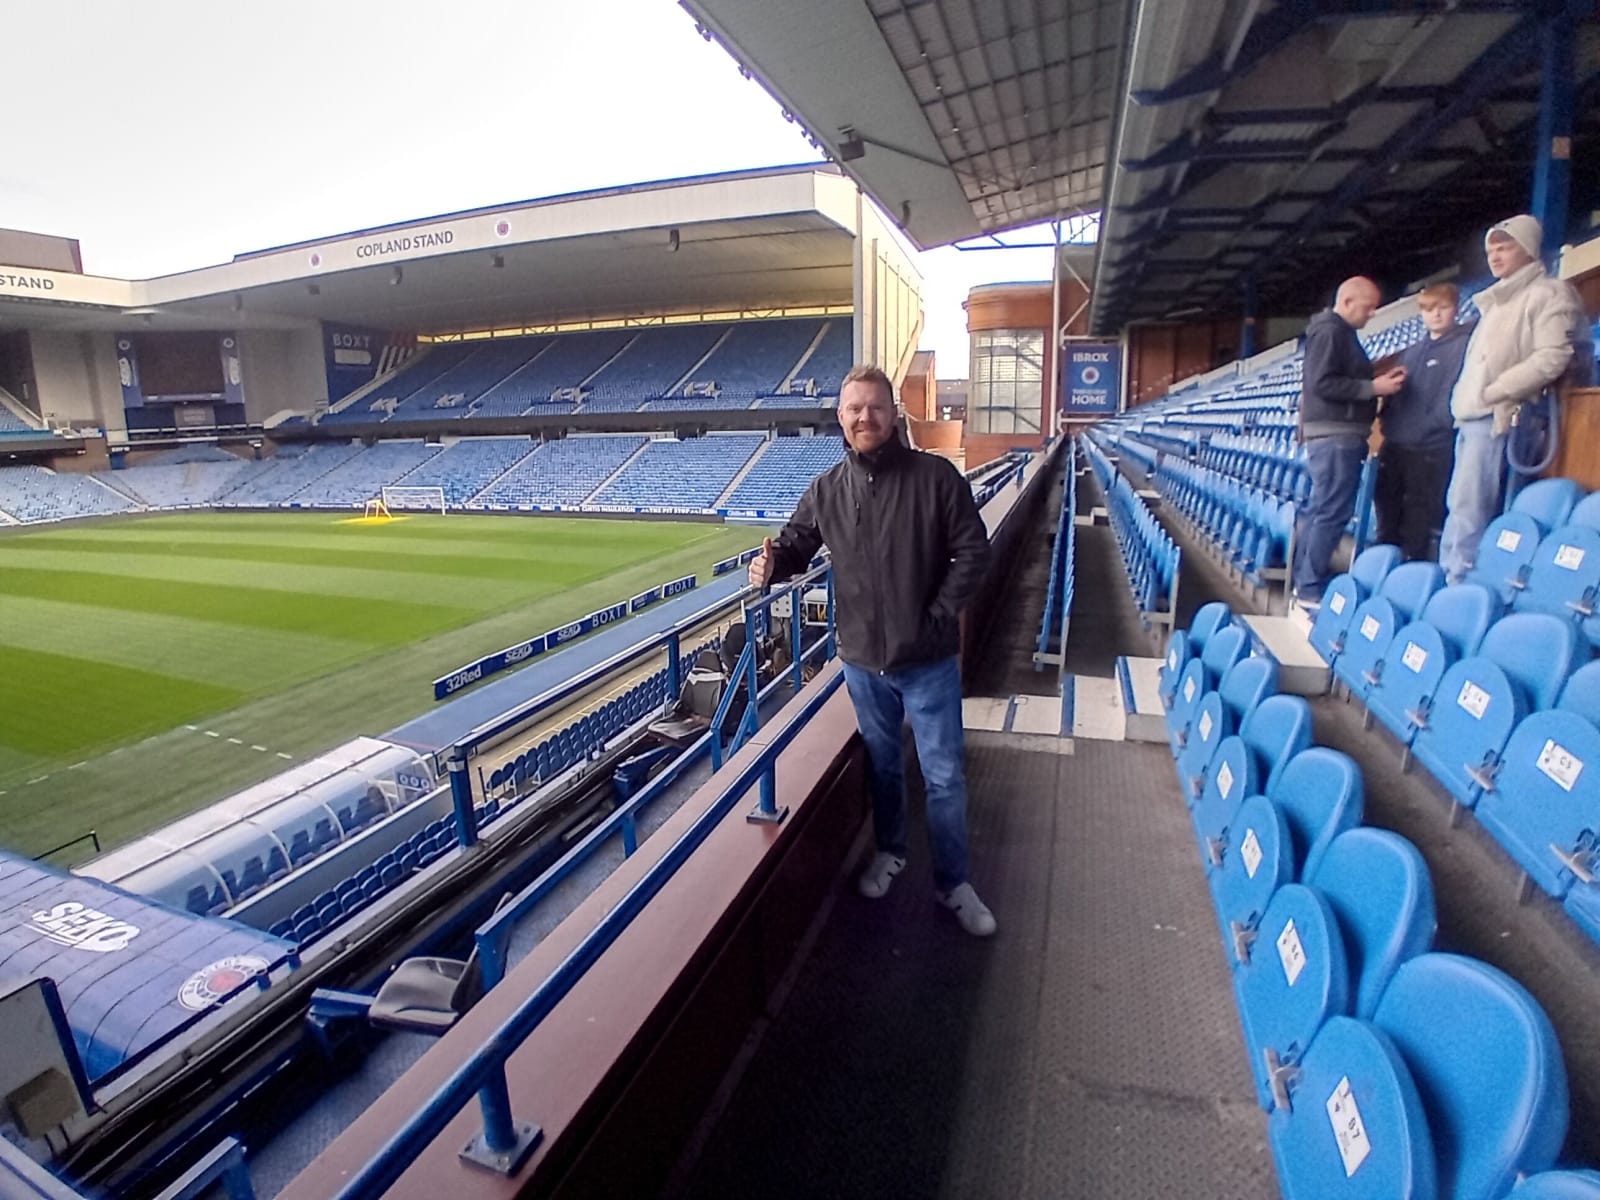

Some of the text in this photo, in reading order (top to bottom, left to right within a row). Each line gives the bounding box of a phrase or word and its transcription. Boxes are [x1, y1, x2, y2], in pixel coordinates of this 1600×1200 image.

[356, 230, 453, 258] COPLAND STAND
[333, 333, 370, 349] BOXT
[1072, 352, 1109, 363] IBROX
[1071, 395, 1107, 405] HOME
[668, 578, 694, 596] BOXT
[592, 606, 621, 628] BOXT
[504, 643, 533, 664] SEKO
[446, 664, 482, 693] 32Red
[31, 902, 140, 952] SEKO
